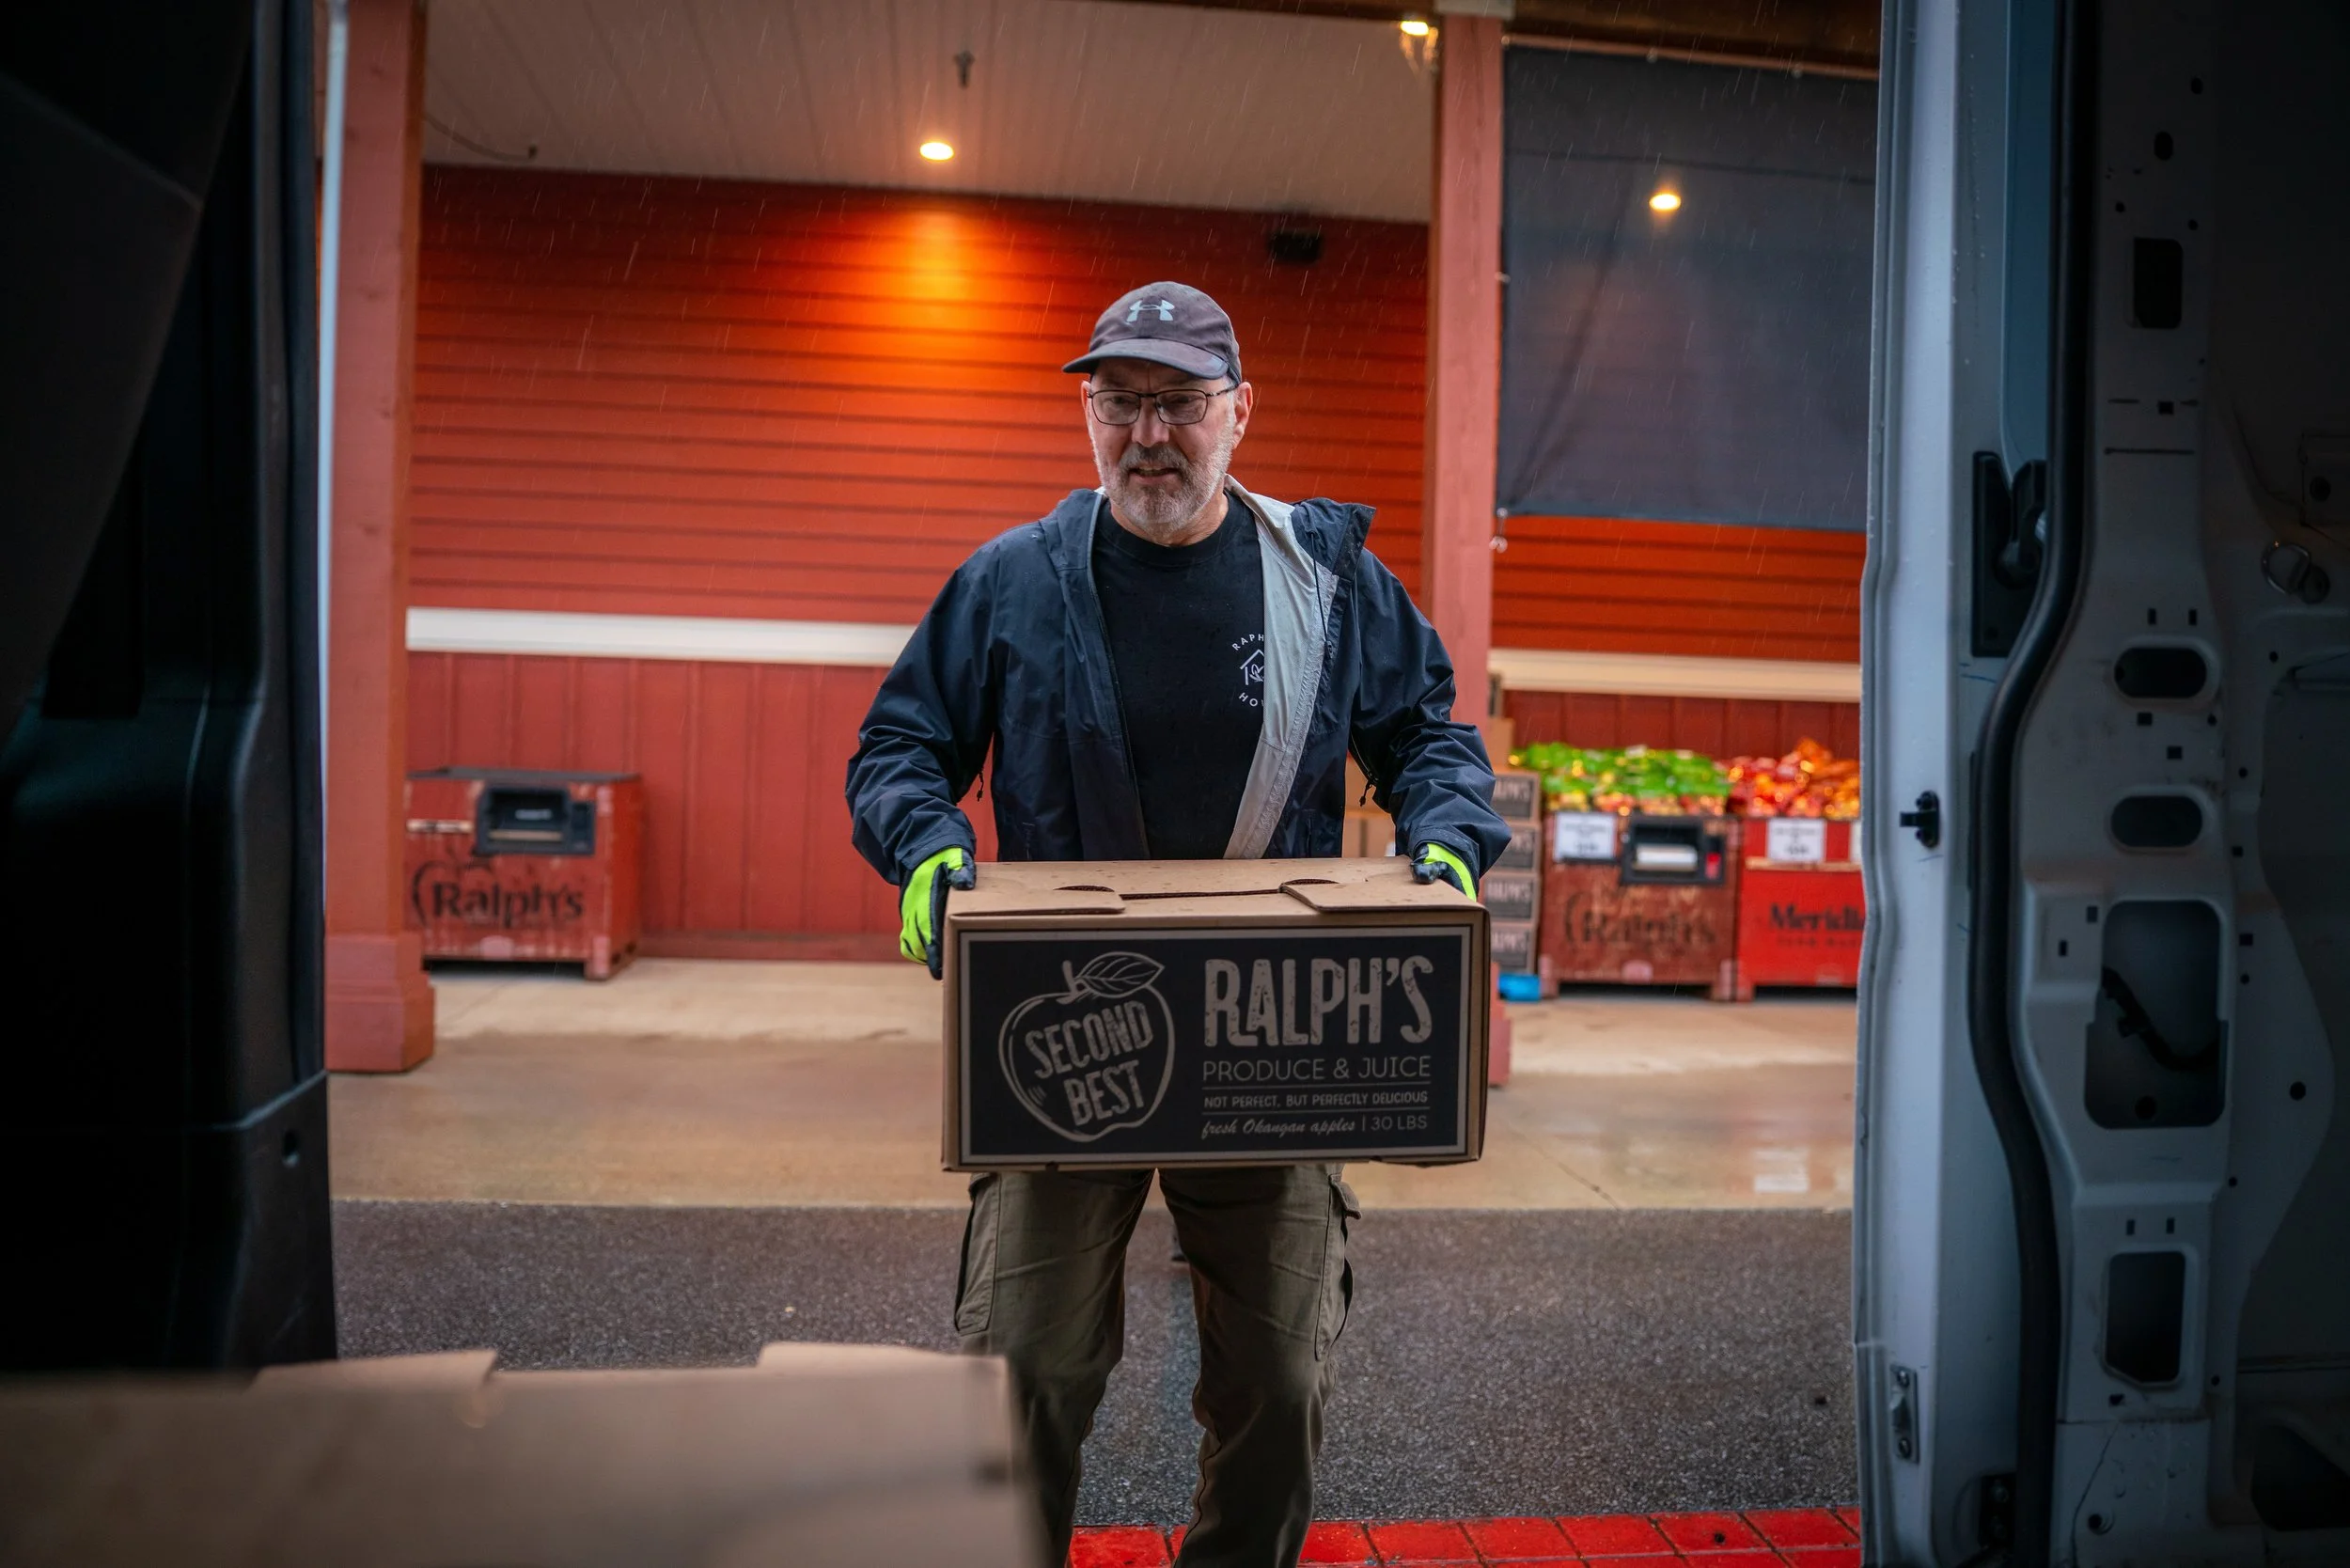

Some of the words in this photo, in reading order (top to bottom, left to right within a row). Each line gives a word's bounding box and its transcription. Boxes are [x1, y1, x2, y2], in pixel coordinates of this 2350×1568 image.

[1238, 692, 1264, 707] HO
[1204, 955, 1434, 1047] RALPH'S
[1025, 1000, 1153, 1079] SECOND
[1203, 1058, 1325, 1082] PRODUCE
[1333, 1058, 1350, 1079] &
[1357, 1055, 1431, 1079] JUICE
[1063, 1059, 1144, 1126] BEST
[1204, 1095, 1228, 1108] NOT
[1286, 1093, 1308, 1107] BUT
[1312, 1092, 1369, 1106] PERFECTLY
[1372, 1090, 1428, 1105] DELICIOUS
[1201, 1119, 1238, 1140] fresh
[1310, 1117, 1355, 1136] apples
[1371, 1116, 1393, 1131] 30
[1397, 1115, 1428, 1130] LBS
